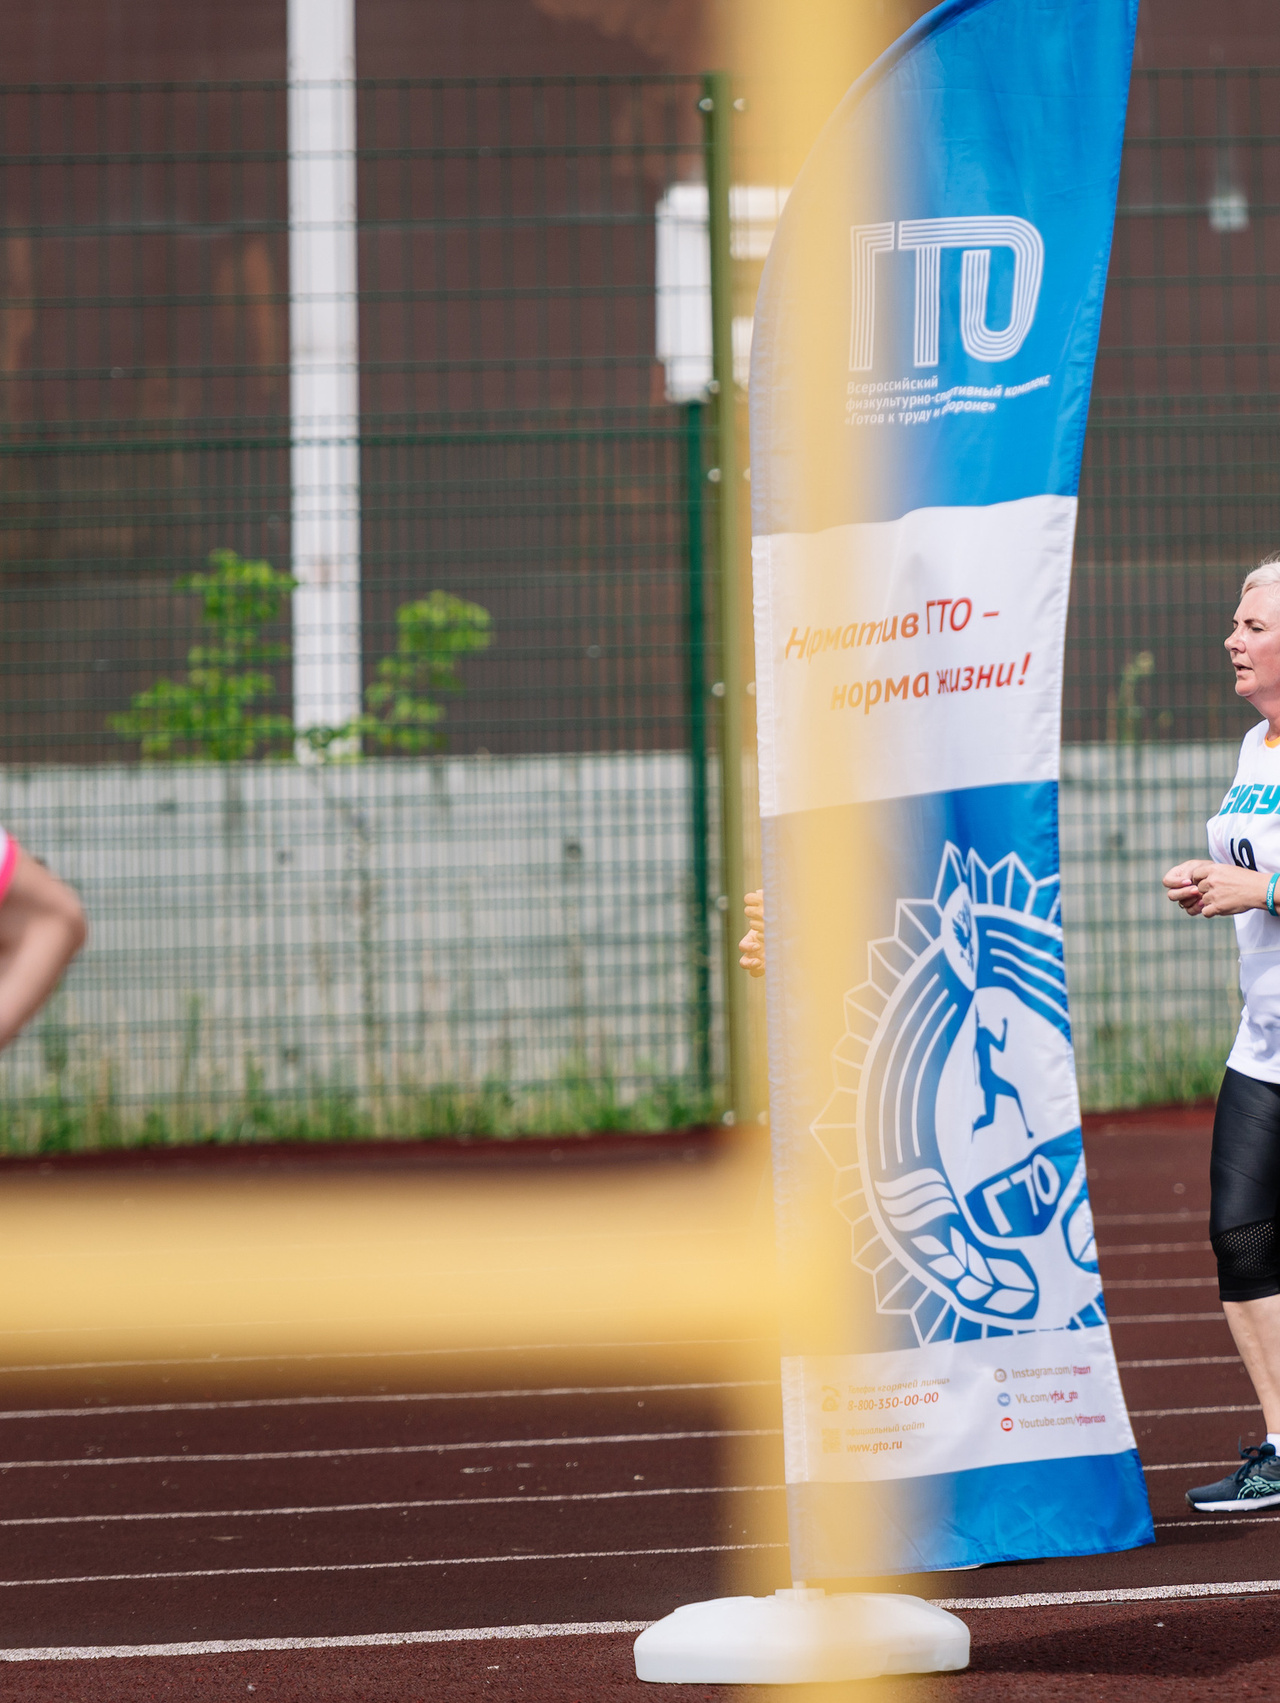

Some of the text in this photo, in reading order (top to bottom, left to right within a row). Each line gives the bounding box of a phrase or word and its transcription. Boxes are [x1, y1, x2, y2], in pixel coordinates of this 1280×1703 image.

[849, 215, 1045, 371] ГТО
[846, 375, 939, 396] Всероссийский
[1004, 374, 1051, 398] комплекс
[888, 412, 895, 424] к
[899, 408, 932, 426] труду
[933, 408, 941, 418] и
[785, 612, 919, 664] Нрматив
[926, 597, 972, 634] ГТО
[830, 652, 1032, 715] норма жизни!
[982, 1153, 1061, 1236] ГТО
[847, 1392, 939, 1411] 8-800-350-00-00
[901, 1421, 925, 1432] сайт
[847, 1440, 903, 1454] www.gto.ru
